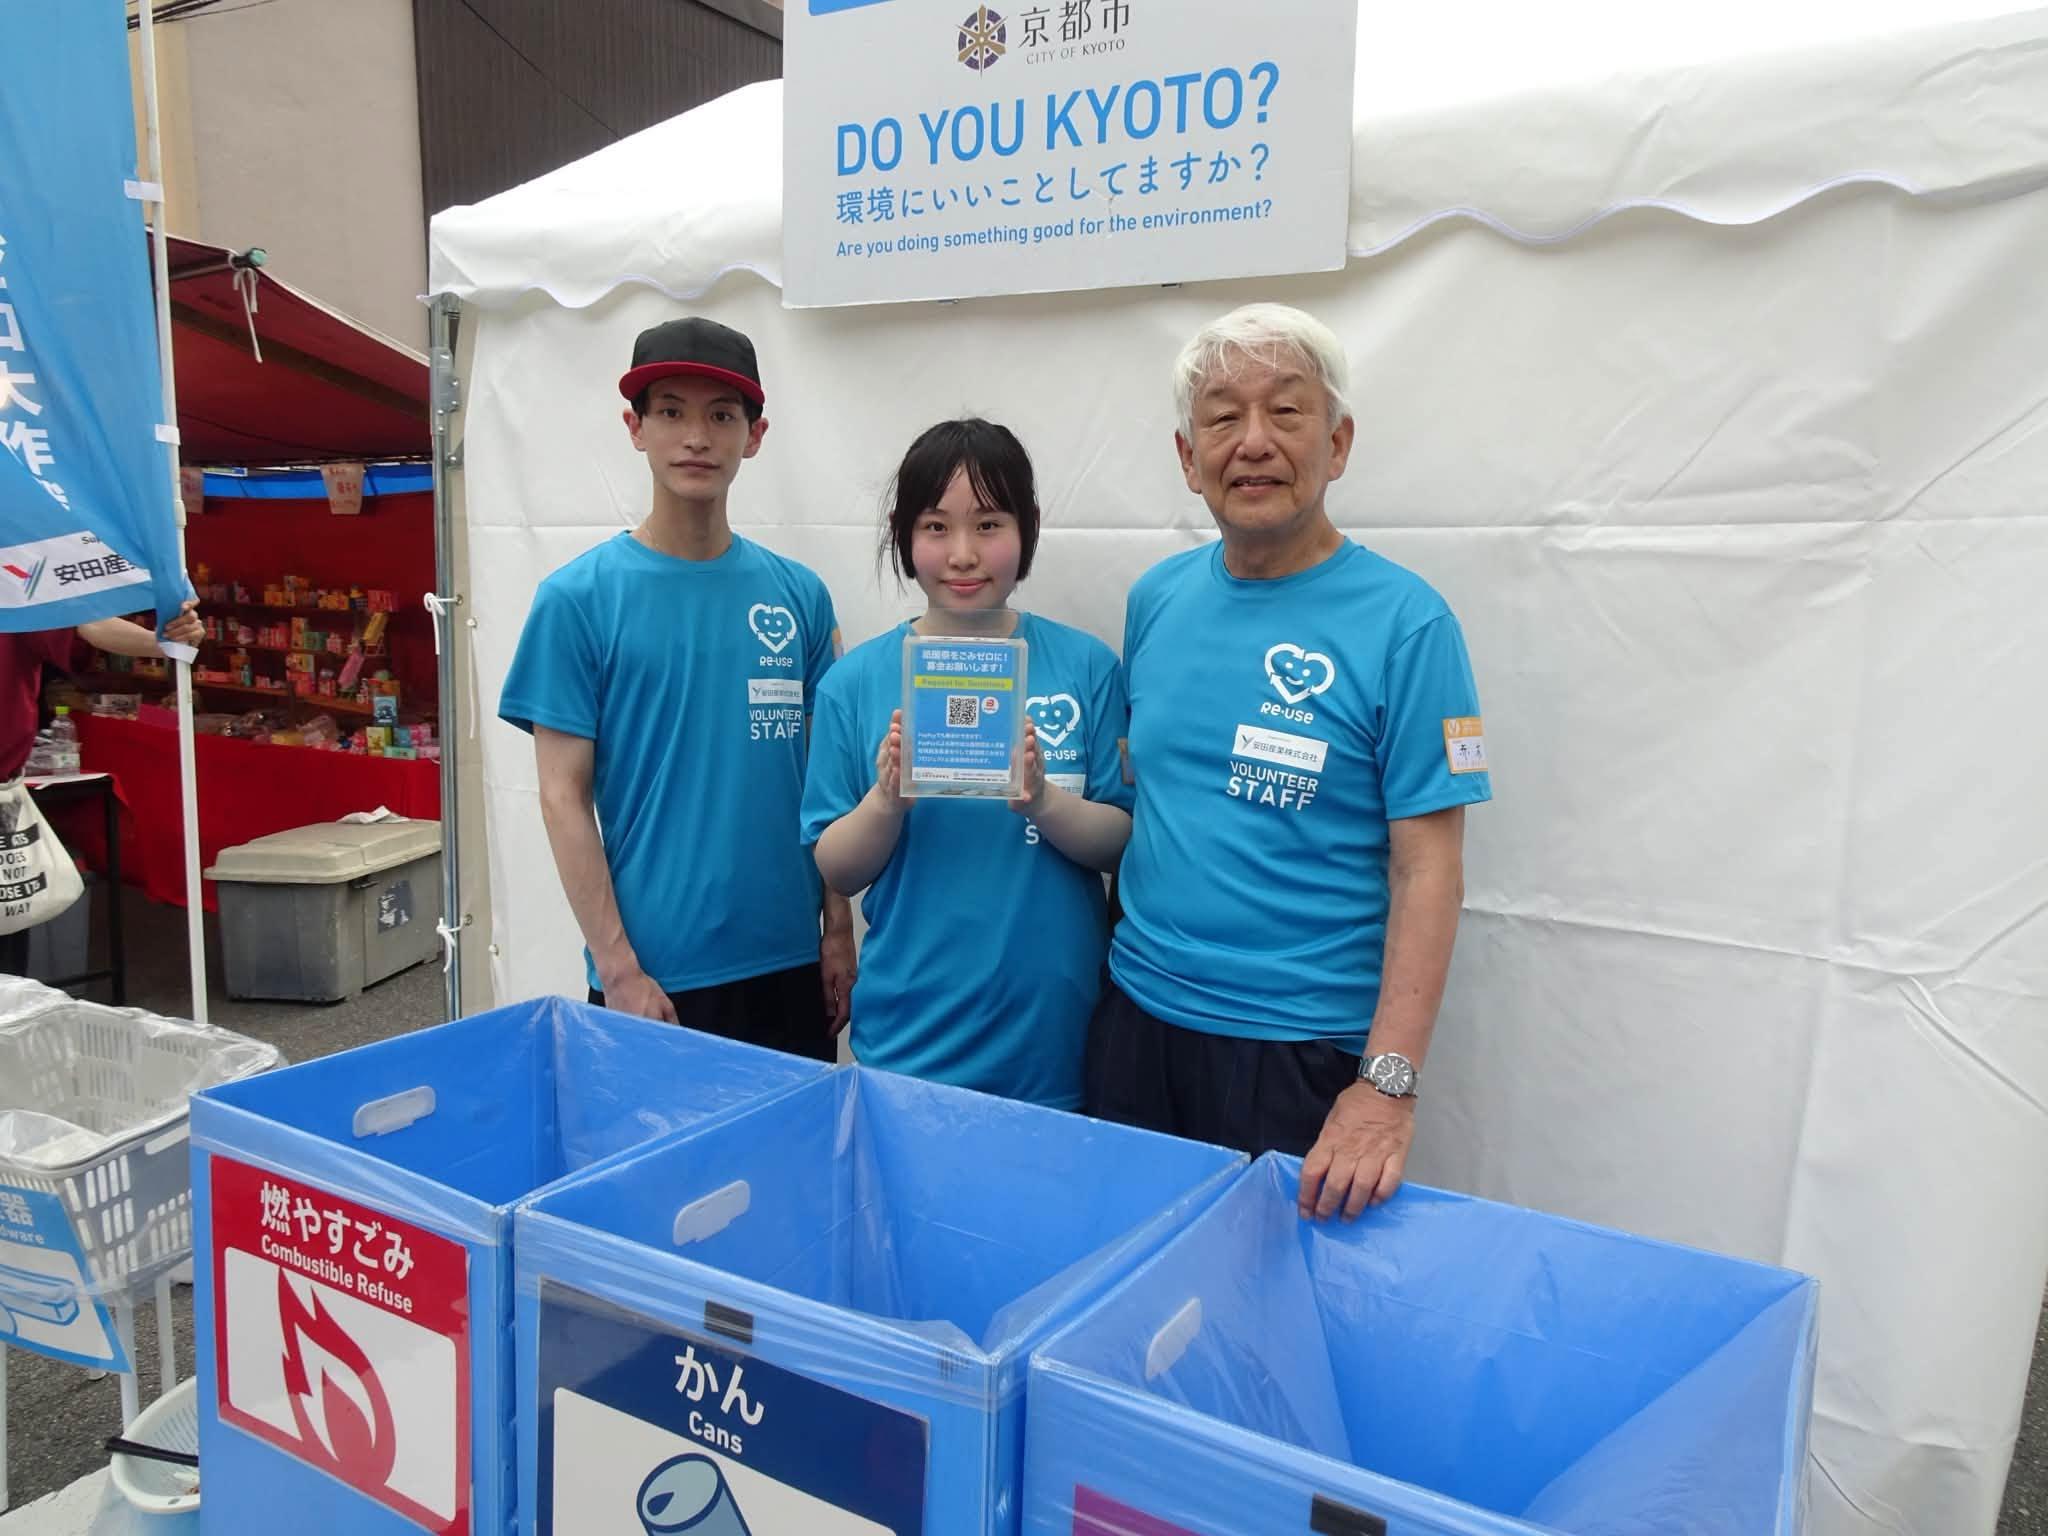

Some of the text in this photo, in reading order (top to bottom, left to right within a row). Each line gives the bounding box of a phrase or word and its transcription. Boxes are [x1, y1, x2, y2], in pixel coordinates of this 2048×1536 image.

[1018, 0, 1130, 49] 京都市
[1026, 38, 1125, 65] CITY OF KYOTO
[837, 61, 1281, 177] DO YOU KYOTO?
[835, 142, 1270, 225] 環境にいいことしてますか?
[836, 199, 1273, 258] Are you doing something good for the environment?
[54, 554, 136, 586] 安田産
[1225, 776, 1316, 811] STAFF
[1229, 760, 1319, 793] VOLUNTEER
[260, 1180, 415, 1280] 燃やすごみ
[261, 1234, 413, 1314] Combustible Refuse
[674, 1345, 765, 1426] かん
[688, 1411, 744, 1454] Cans
